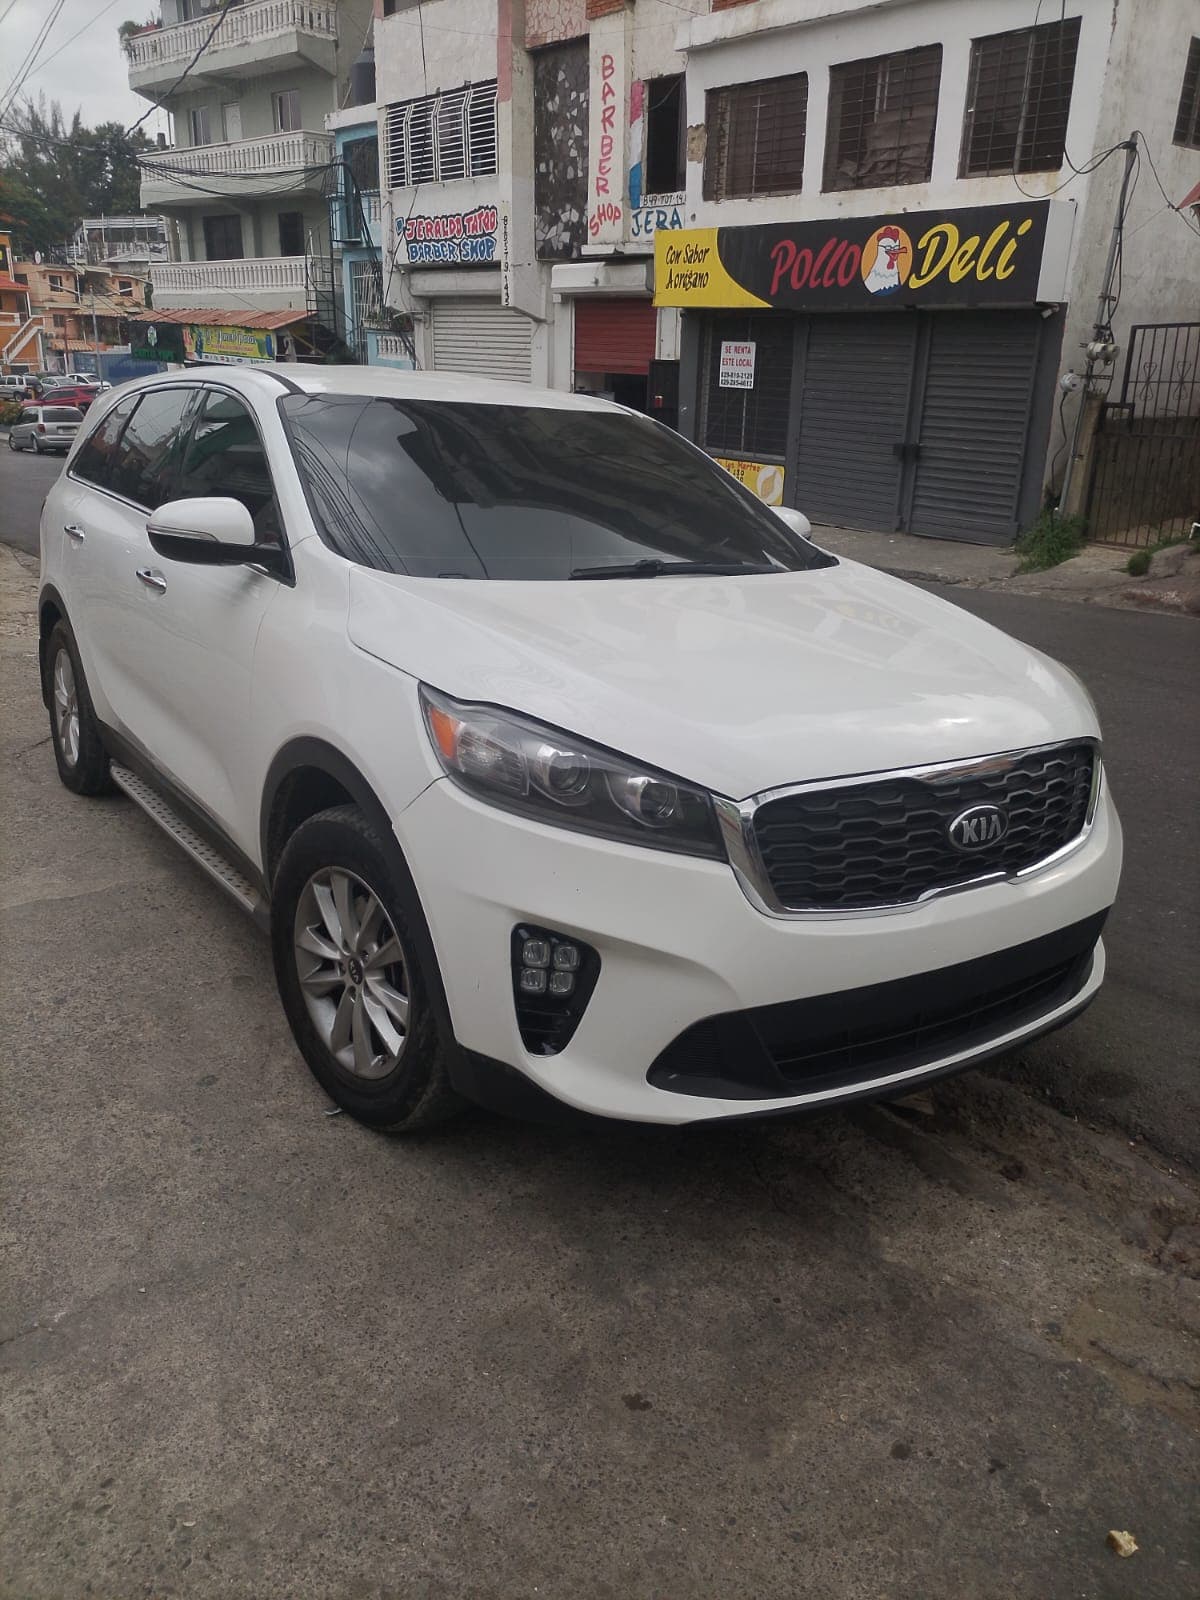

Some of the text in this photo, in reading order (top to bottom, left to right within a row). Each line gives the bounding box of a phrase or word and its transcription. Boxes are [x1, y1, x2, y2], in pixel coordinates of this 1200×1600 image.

[595, 54, 616, 198] BARBER
[404, 214, 463, 241] JERALDO
[589, 203, 622, 236] SHOP
[407, 236, 497, 263] BARBER SHOP
[666, 243, 710, 264] Con Sabor
[769, 218, 1033, 296] Pollo Deli
[722, 357, 753, 367] ESTE LOCAL
[725, 345, 752, 355] SE RENTA
[961, 814, 1002, 844] KIA
